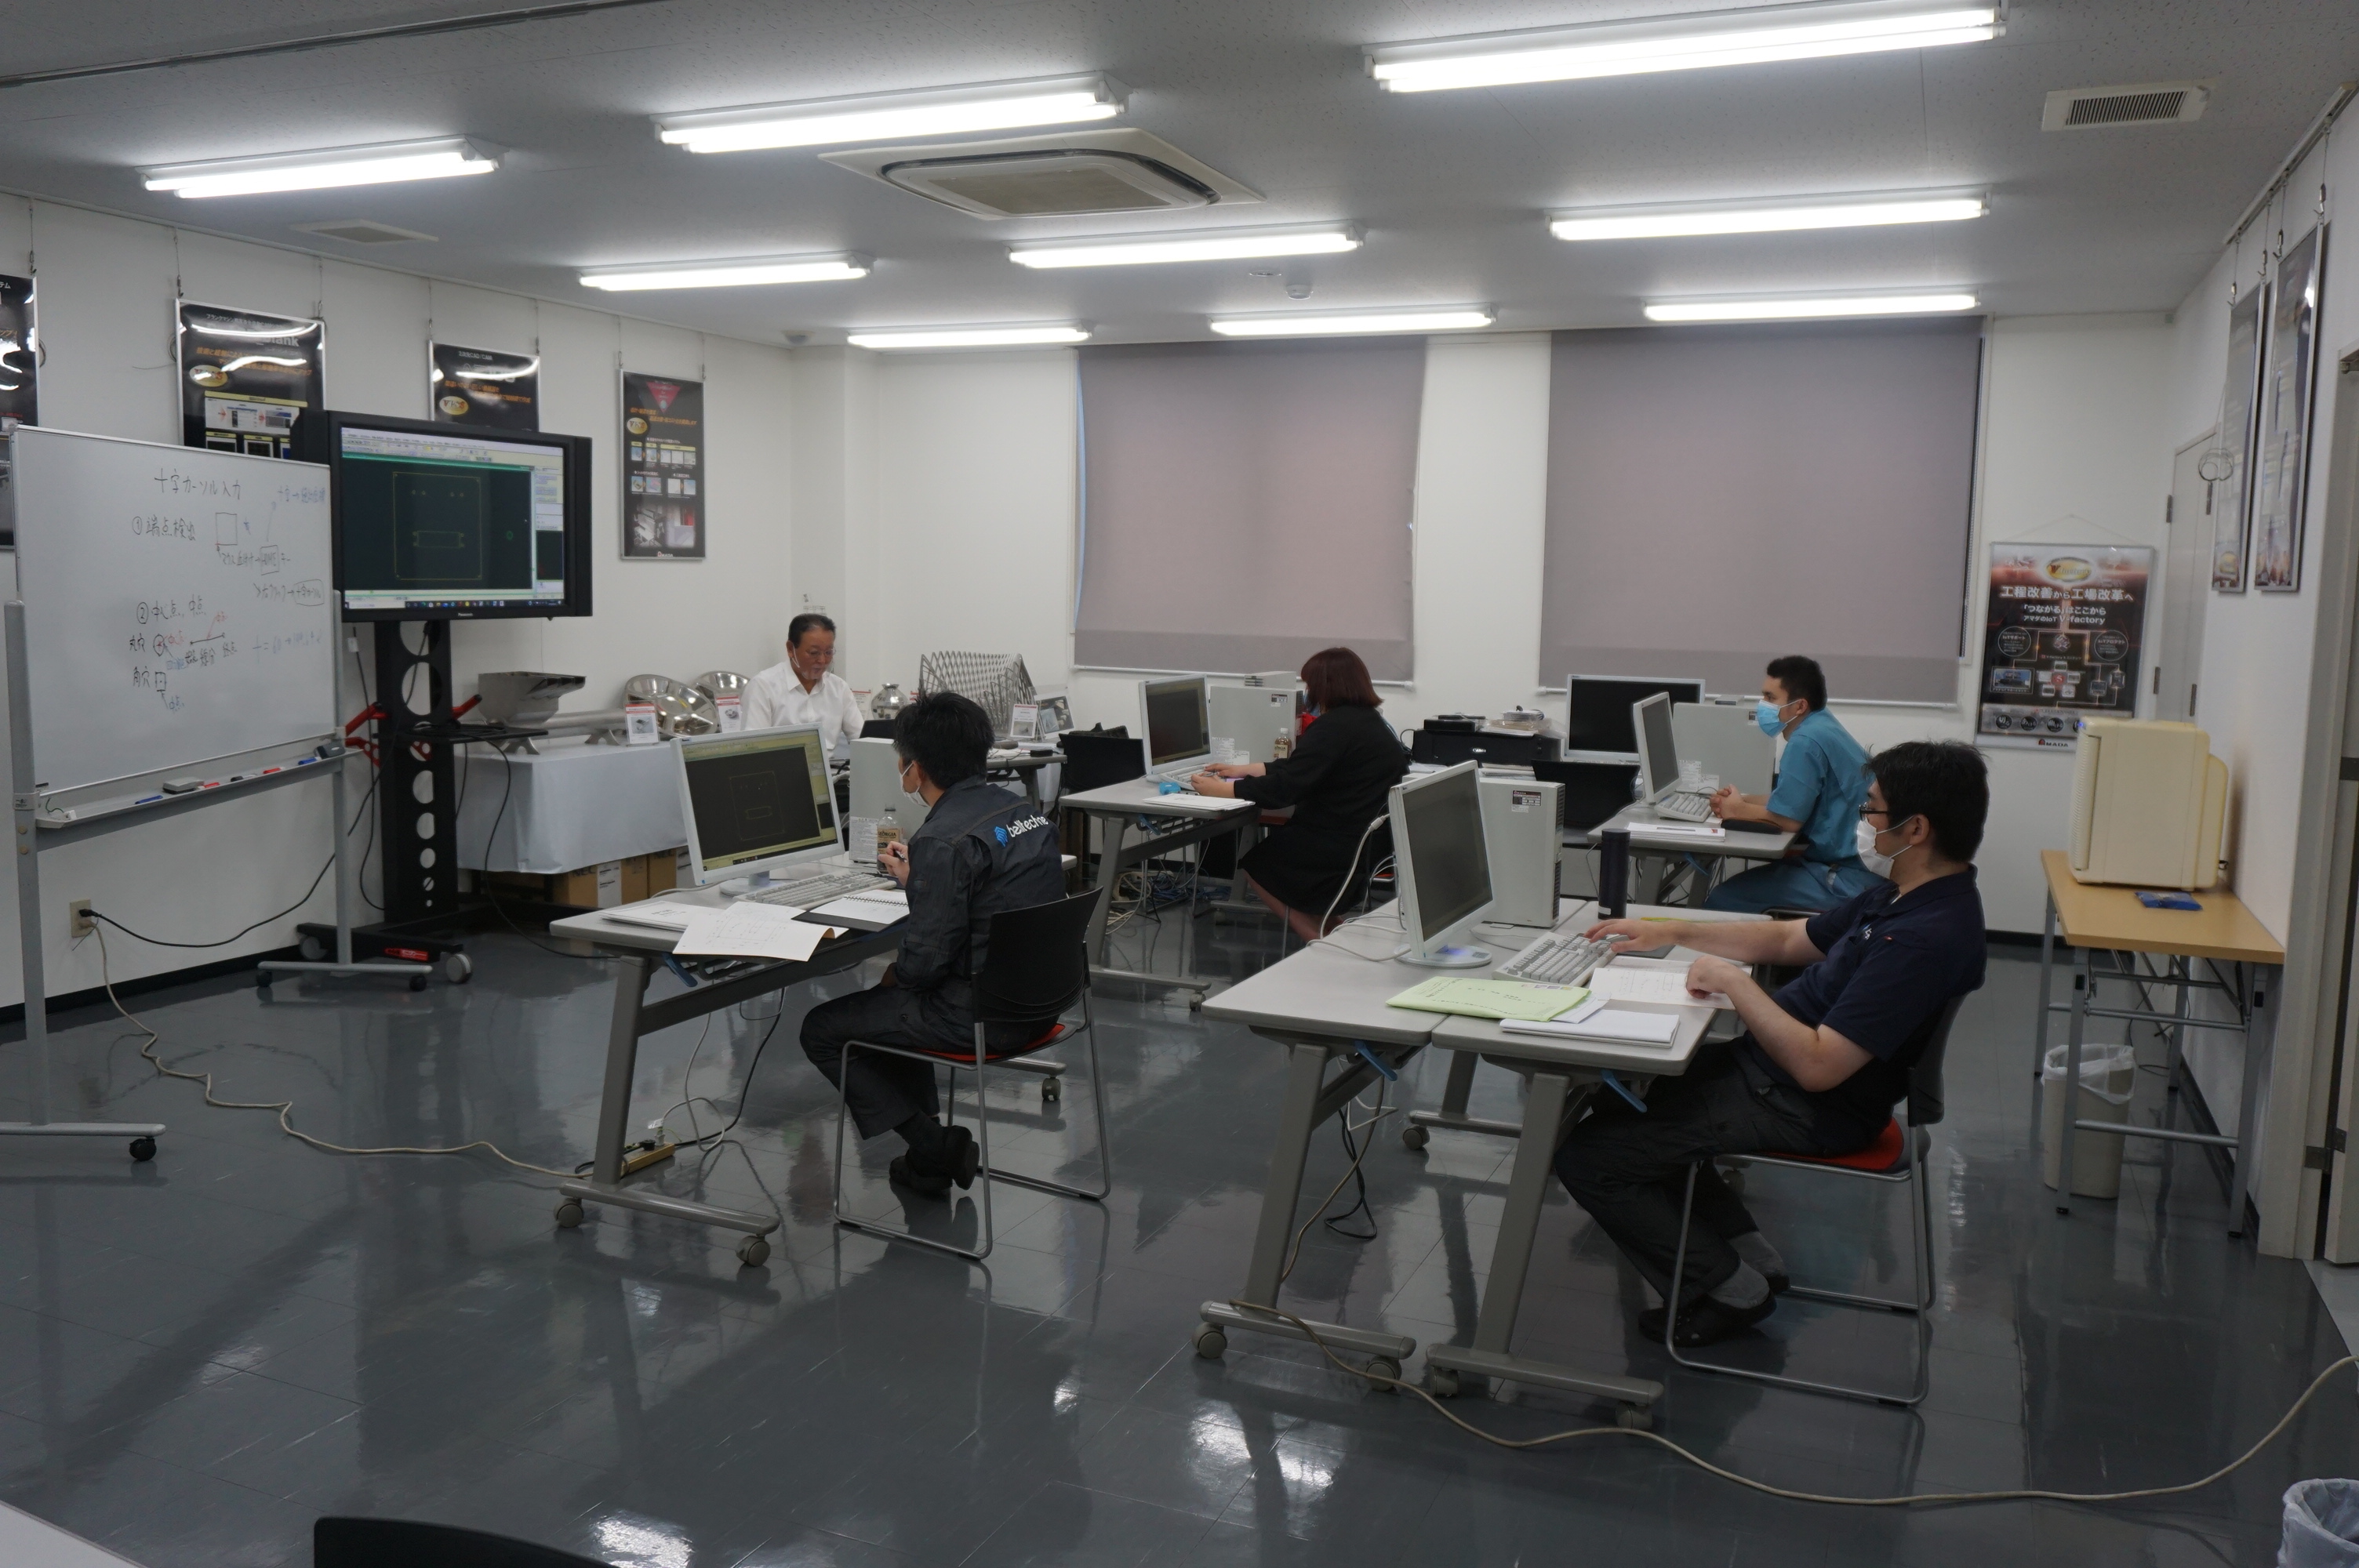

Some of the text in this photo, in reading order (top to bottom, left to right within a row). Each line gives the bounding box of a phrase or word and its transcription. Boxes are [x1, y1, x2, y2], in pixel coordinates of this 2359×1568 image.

[2001, 585, 2134, 602] 工程改善から工場改革へ
[2059, 615, 2106, 625] V-factory
[2038, 739, 2069, 747] AMADA
[1005, 814, 1049, 838] belltechne
